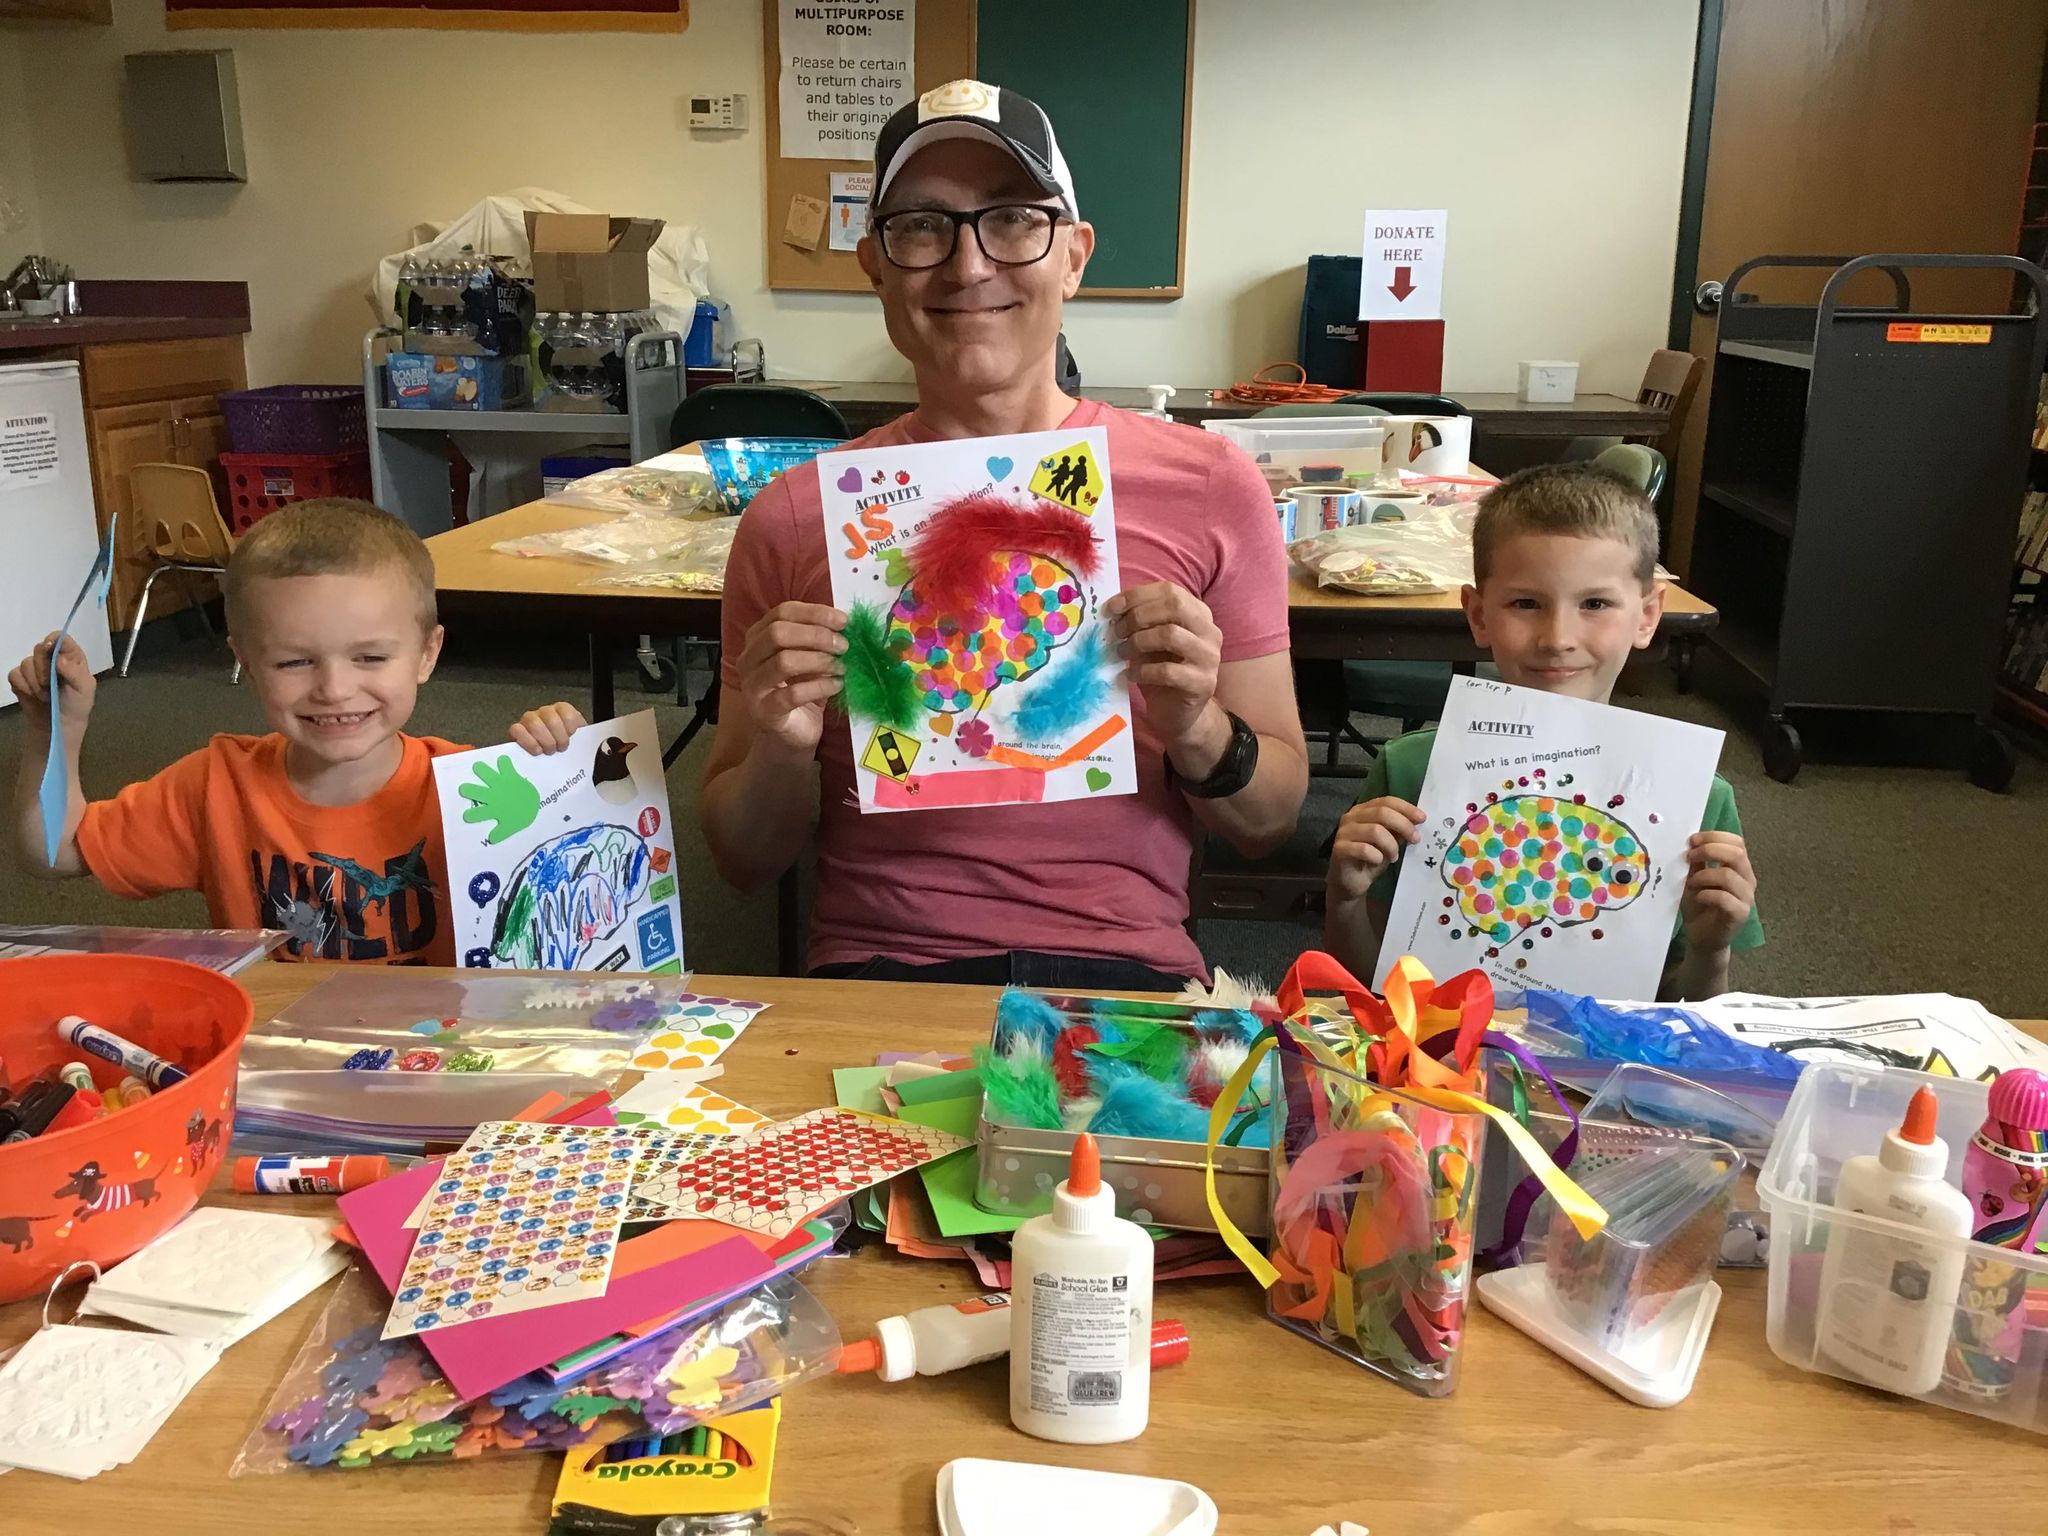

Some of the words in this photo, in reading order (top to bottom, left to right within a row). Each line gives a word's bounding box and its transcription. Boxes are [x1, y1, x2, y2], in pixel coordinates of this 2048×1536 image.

[795, 8, 904, 20] MULTIPURPOSE
[826, 24, 872, 36] ROOM:
[792, 57, 834, 69] Please
[839, 57, 855, 69] be
[860, 58, 906, 71] certain
[797, 75, 811, 86] to
[816, 76, 856, 87] return
[861, 76, 902, 89] chairs
[806, 92, 830, 104] and
[835, 93, 875, 106] tables
[880, 95, 893, 106] to
[807, 111, 839, 123] their
[1375, 226, 1435, 239] DONATE
[1384, 249, 1423, 261] HERE
[1326, 324, 1357, 334] Dollar
[855, 485, 923, 513] ACTIVITY
[868, 533, 897, 556] What
[900, 528, 910, 539] is
[914, 519, 927, 532] an
[1468, 720, 1535, 737] ACTIVITY
[1465, 759, 1496, 771] What
[1500, 757, 1510, 766] is
[1514, 755, 1528, 765] an
[1532, 745, 1601, 763] imagination?
[1490, 970, 1508, 983] draw
[1504, 966, 1517, 976] and
[1519, 972, 1543, 987] around
[1545, 983, 1557, 992] the
[1061, 1282, 1088, 1293] School
[1089, 1283, 1109, 1294] Glue
[598, 1459, 737, 1482] Crayola
